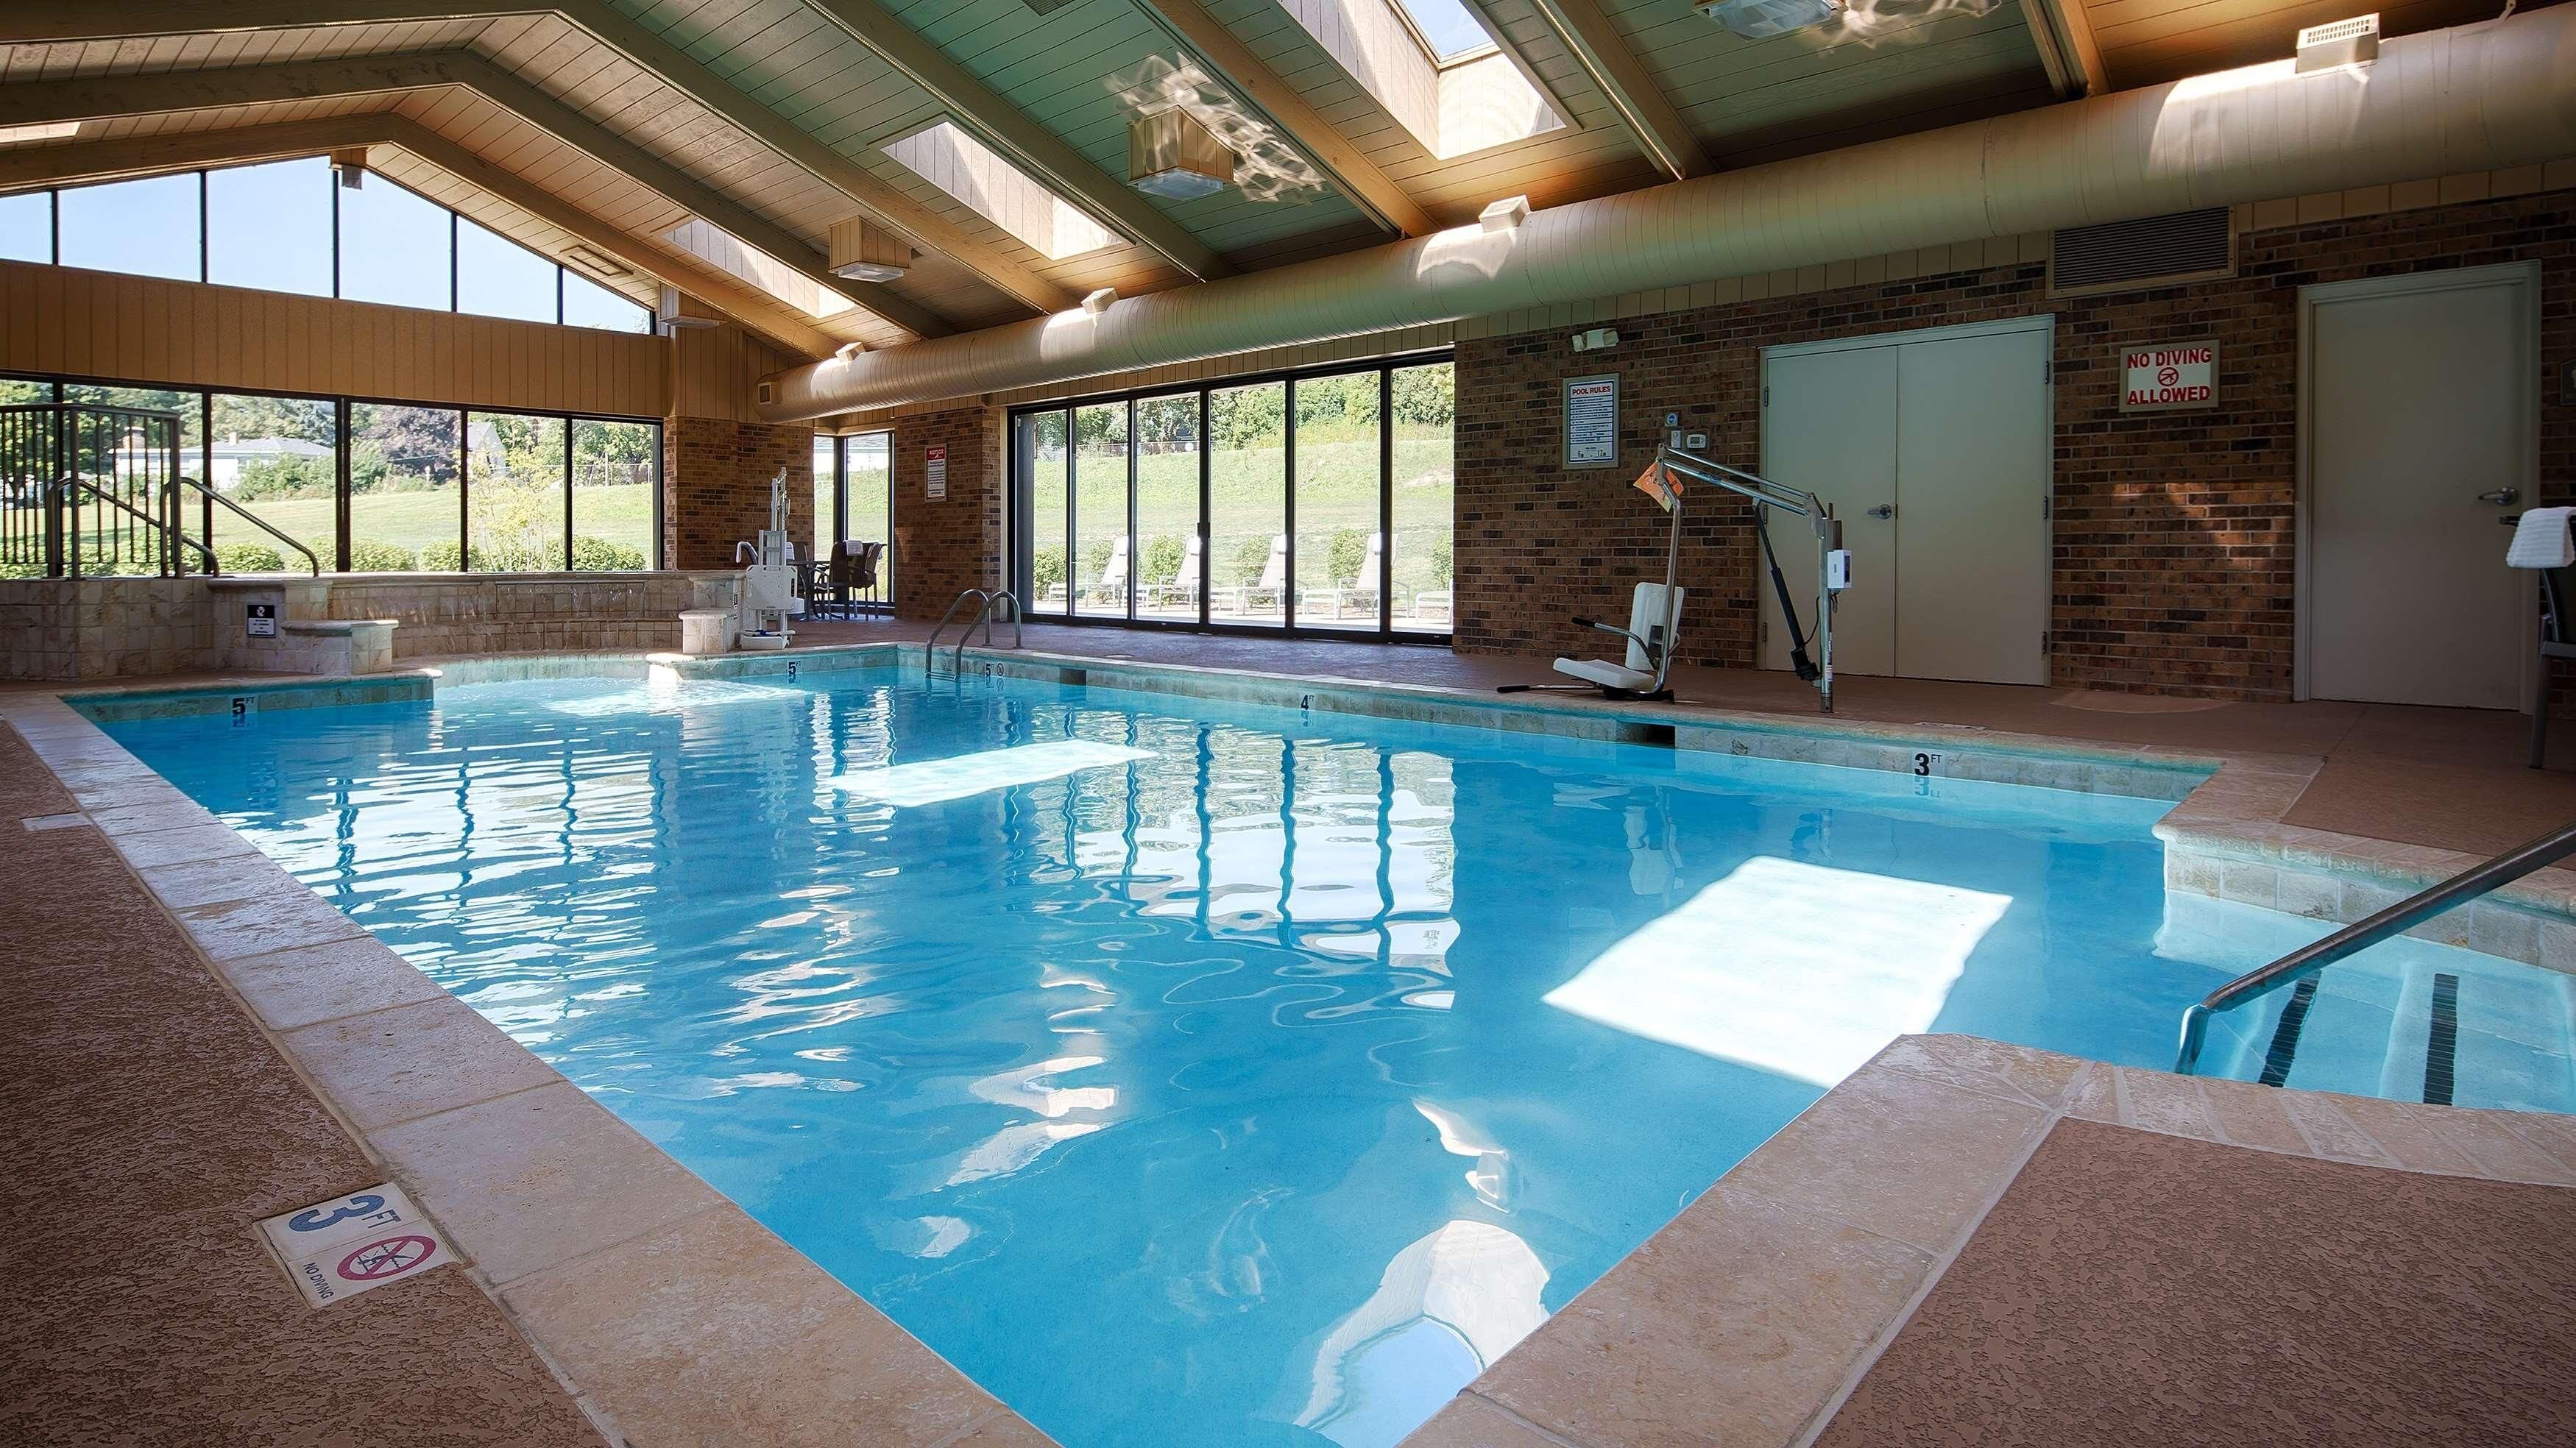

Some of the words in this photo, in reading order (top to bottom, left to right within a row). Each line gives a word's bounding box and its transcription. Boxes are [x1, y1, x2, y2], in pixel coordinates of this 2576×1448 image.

[2127, 353, 2151, 369] NO
[2155, 348, 2212, 366] DIVING
[1590, 386, 1610, 394] RULES
[2127, 386, 2211, 405] ALLOWED
[788, 661, 796, 674] 5
[986, 663, 991, 676] 5
[232, 698, 246, 714] 5
[1301, 695, 1309, 710] 4
[1914, 753, 1930, 776] 3
[1931, 753, 1942, 764] FT
[289, 1194, 386, 1232] 3
[361, 1209, 402, 1229] FT
[303, 1262, 319, 1274] NO
[310, 1274, 335, 1299] DIVING
